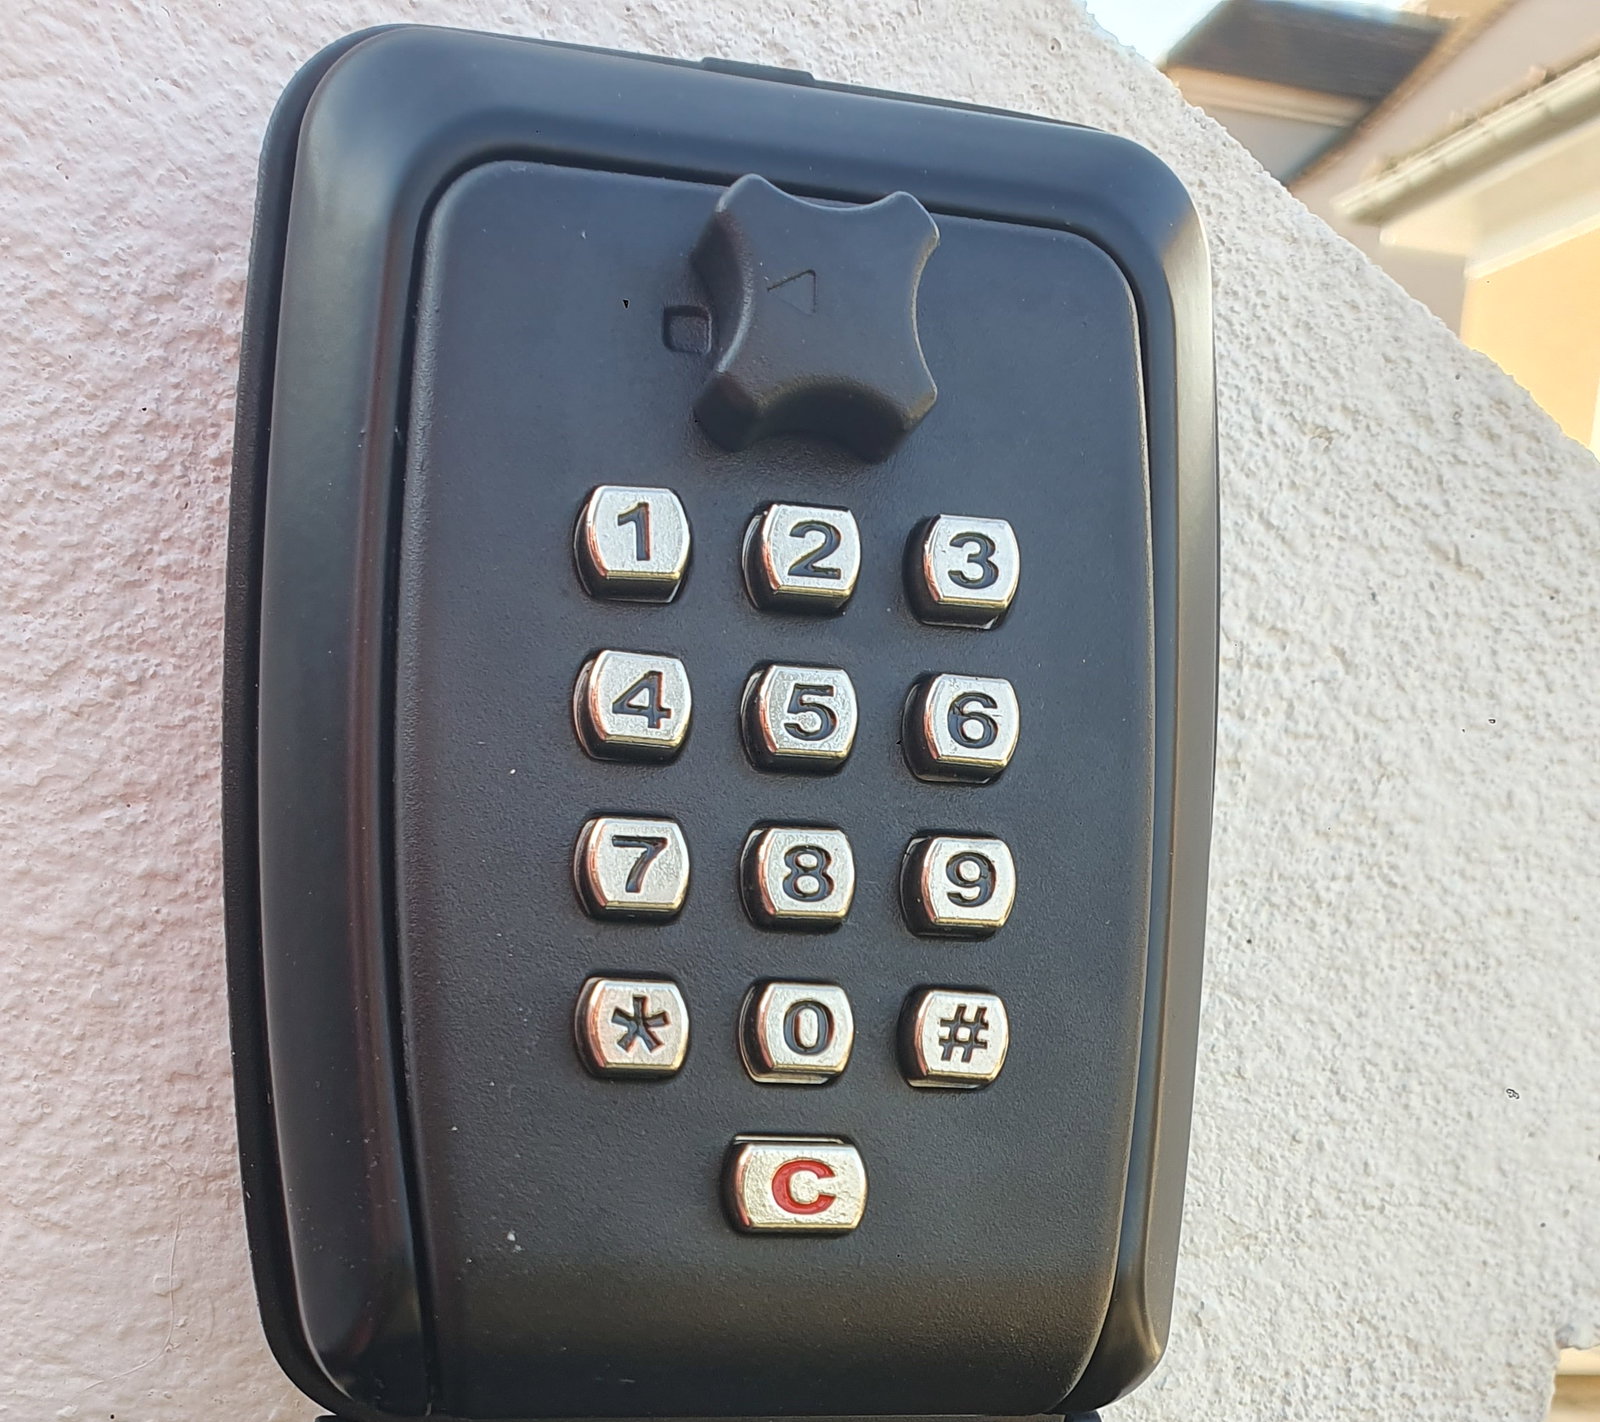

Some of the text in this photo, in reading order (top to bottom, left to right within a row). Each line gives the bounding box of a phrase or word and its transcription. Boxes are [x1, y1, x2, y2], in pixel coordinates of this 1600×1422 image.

[617, 501, 651, 561] 1
[788, 520, 842, 579] 2
[947, 531, 999, 589] 3
[611, 670, 672, 729] 4
[783, 684, 837, 741] 5
[947, 692, 998, 749] 6
[612, 835, 668, 893] 7
[782, 845, 835, 902] 8
[945, 851, 997, 907] 9
[939, 1004, 988, 1062] #
[771, 1159, 836, 1215] C
